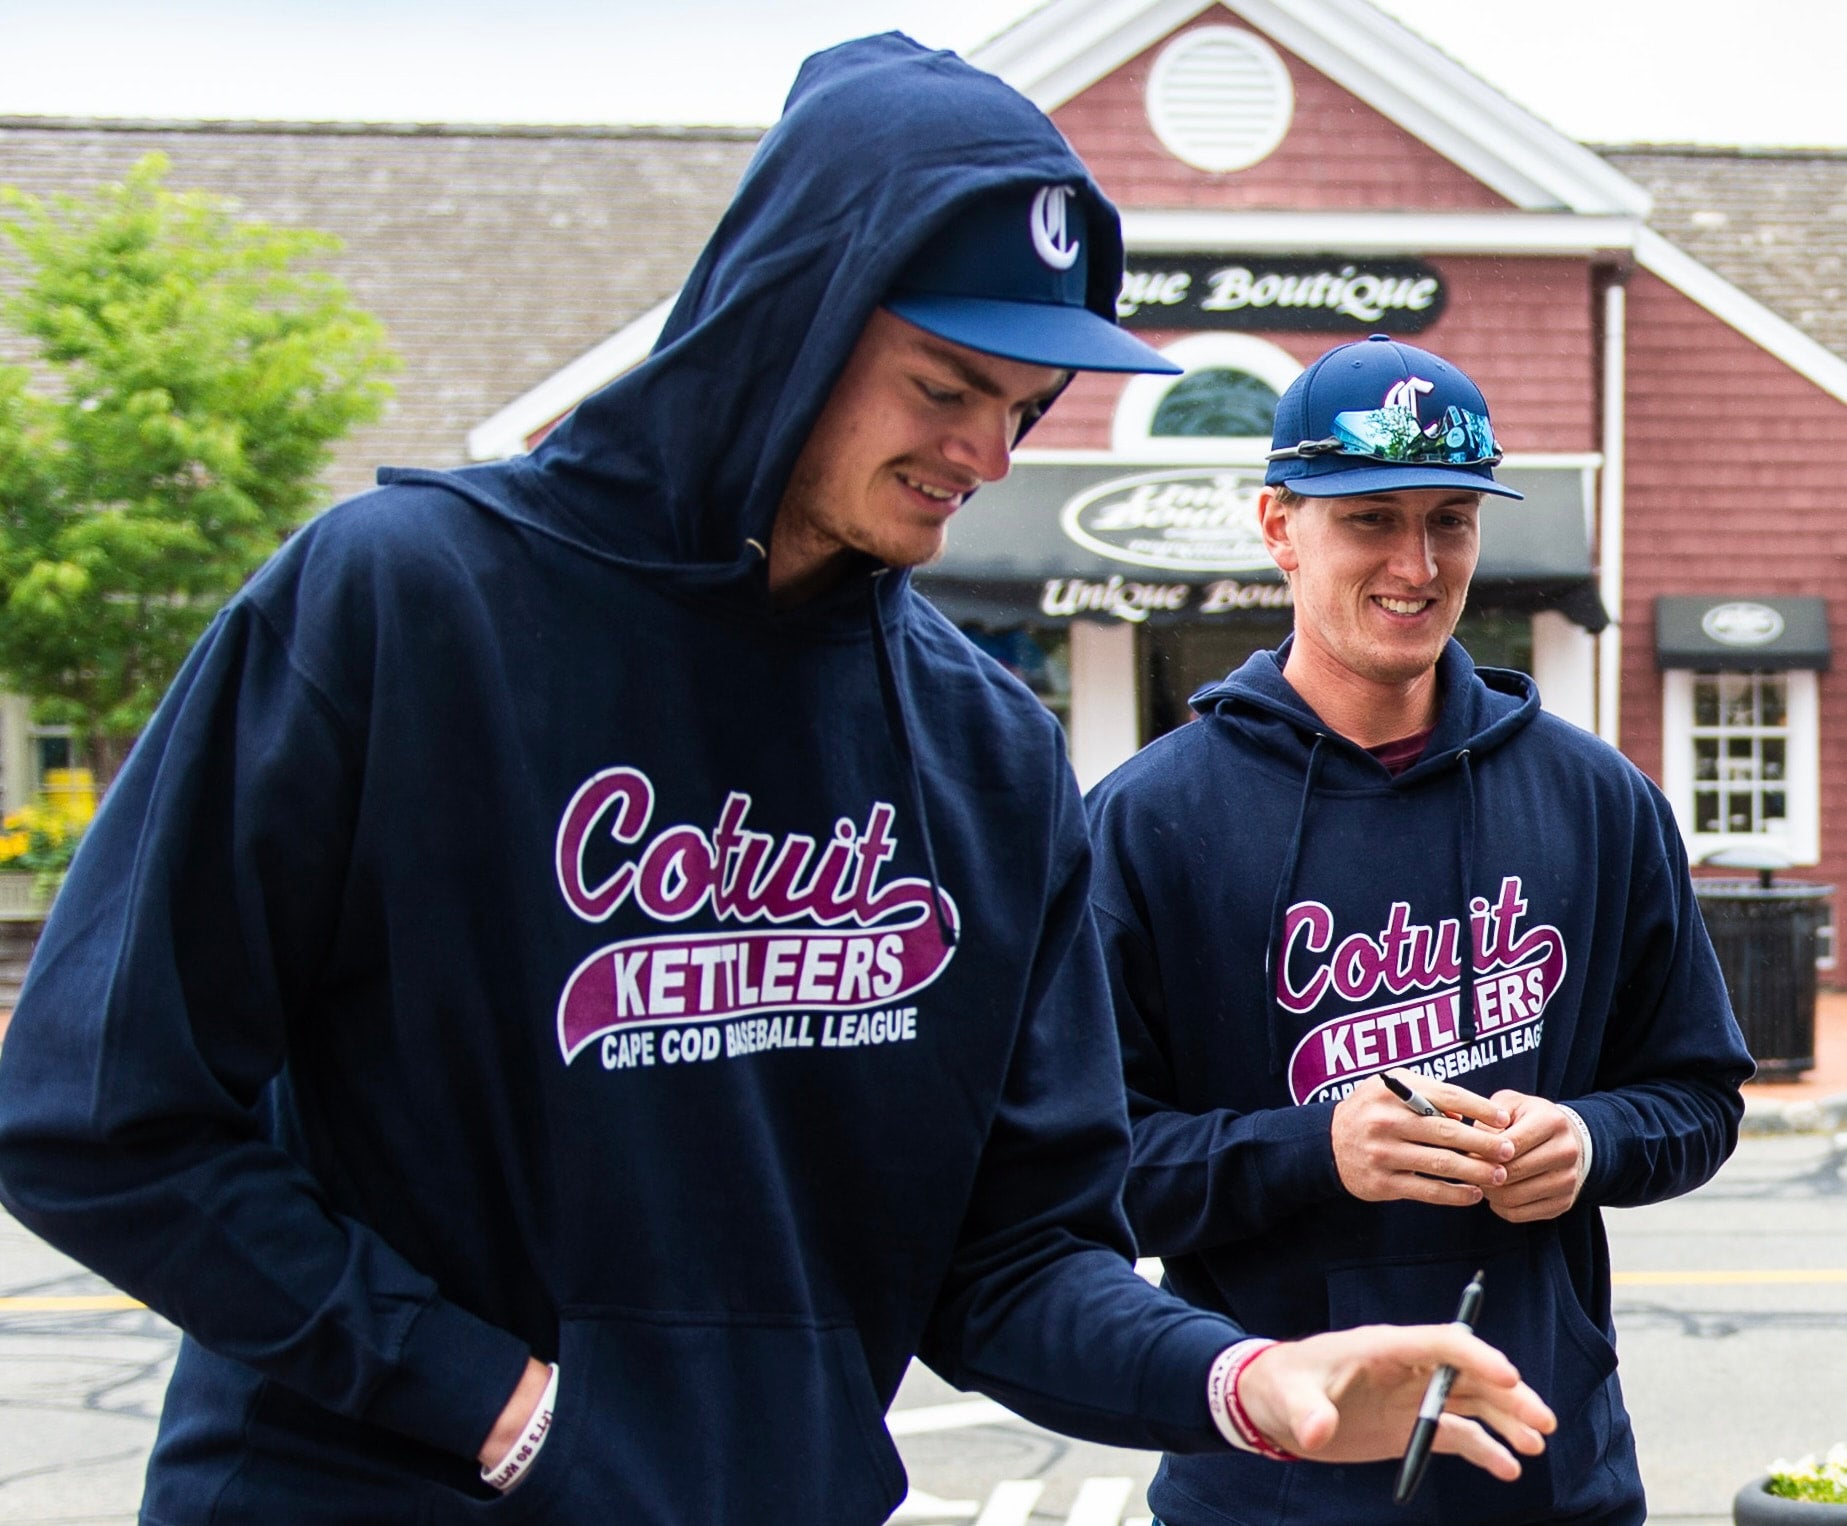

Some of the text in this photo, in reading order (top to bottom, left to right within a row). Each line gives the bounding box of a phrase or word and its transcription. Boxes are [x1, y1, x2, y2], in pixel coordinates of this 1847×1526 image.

[556, 766, 900, 926] Cotuit
[613, 934, 904, 1018] KETTLEERS
[1276, 876, 1528, 1014] Cotuit
[601, 1007, 919, 1070] CAPE COD BASEBALL LEAGUE
[1500, 1019, 1544, 1059] LEAG
